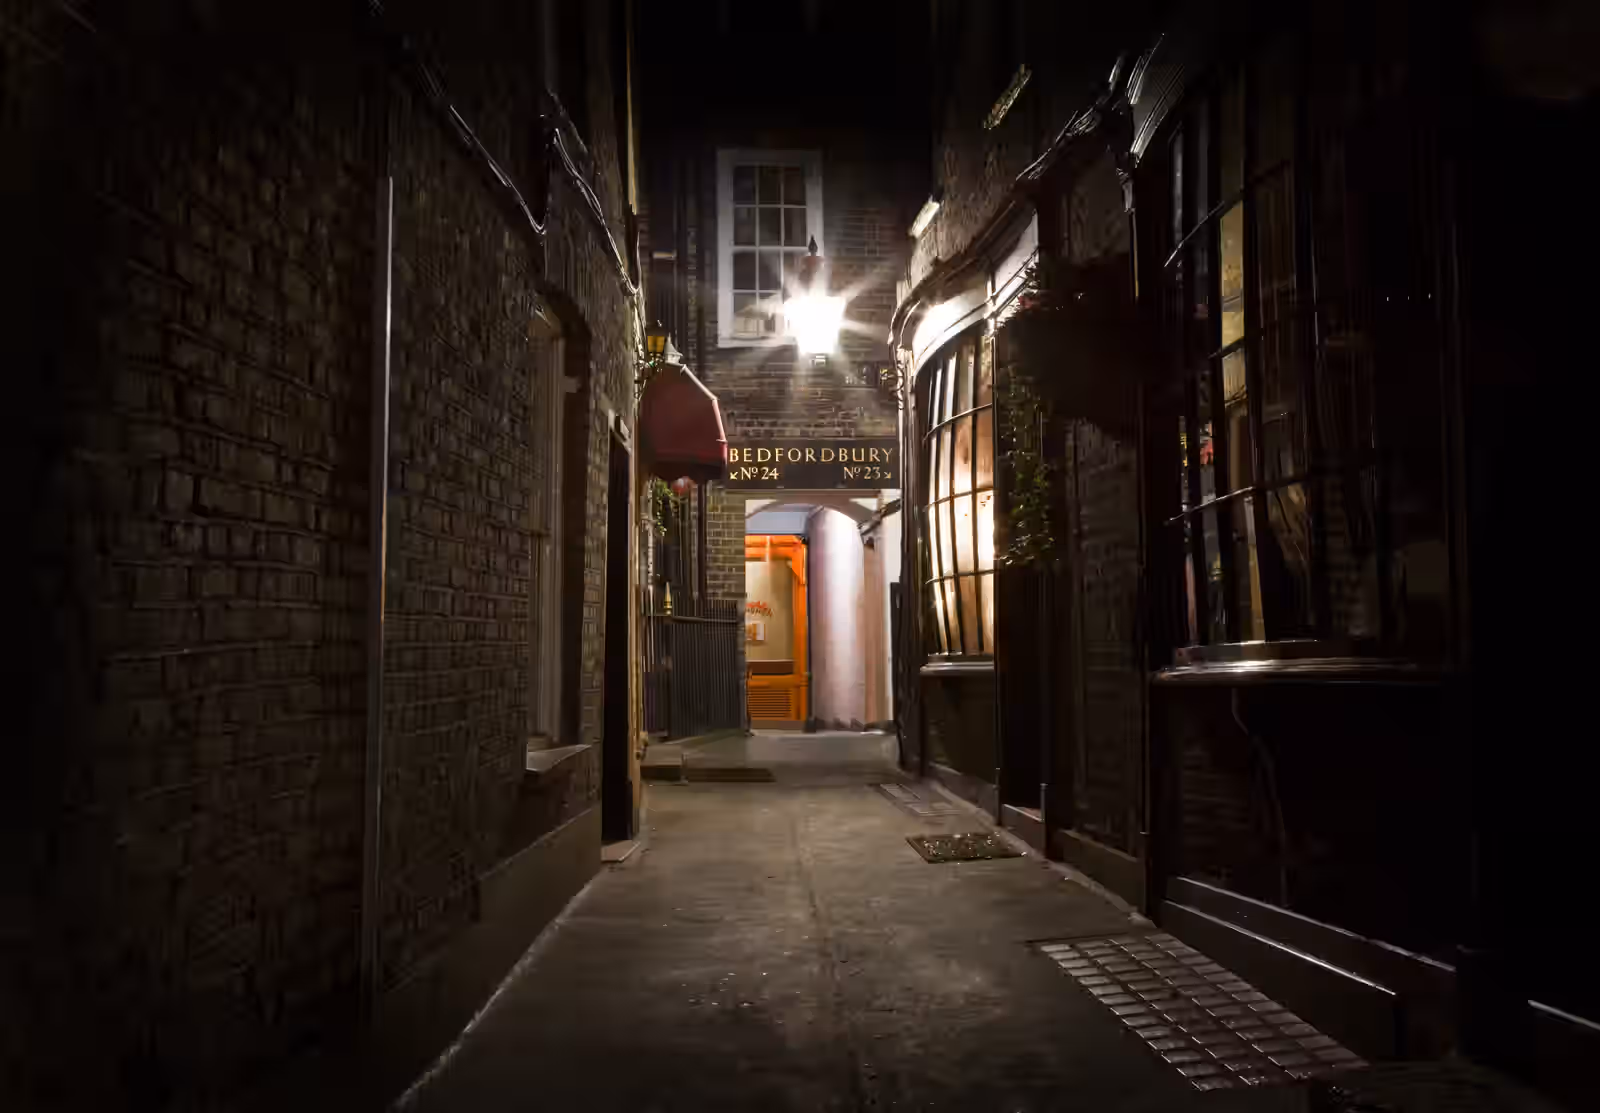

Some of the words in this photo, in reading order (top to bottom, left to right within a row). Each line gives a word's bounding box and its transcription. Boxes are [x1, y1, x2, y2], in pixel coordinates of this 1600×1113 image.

[729, 447, 893, 463] BEDFORDBURY
[761, 467, 779, 480] 24
[864, 467, 881, 480] 23
